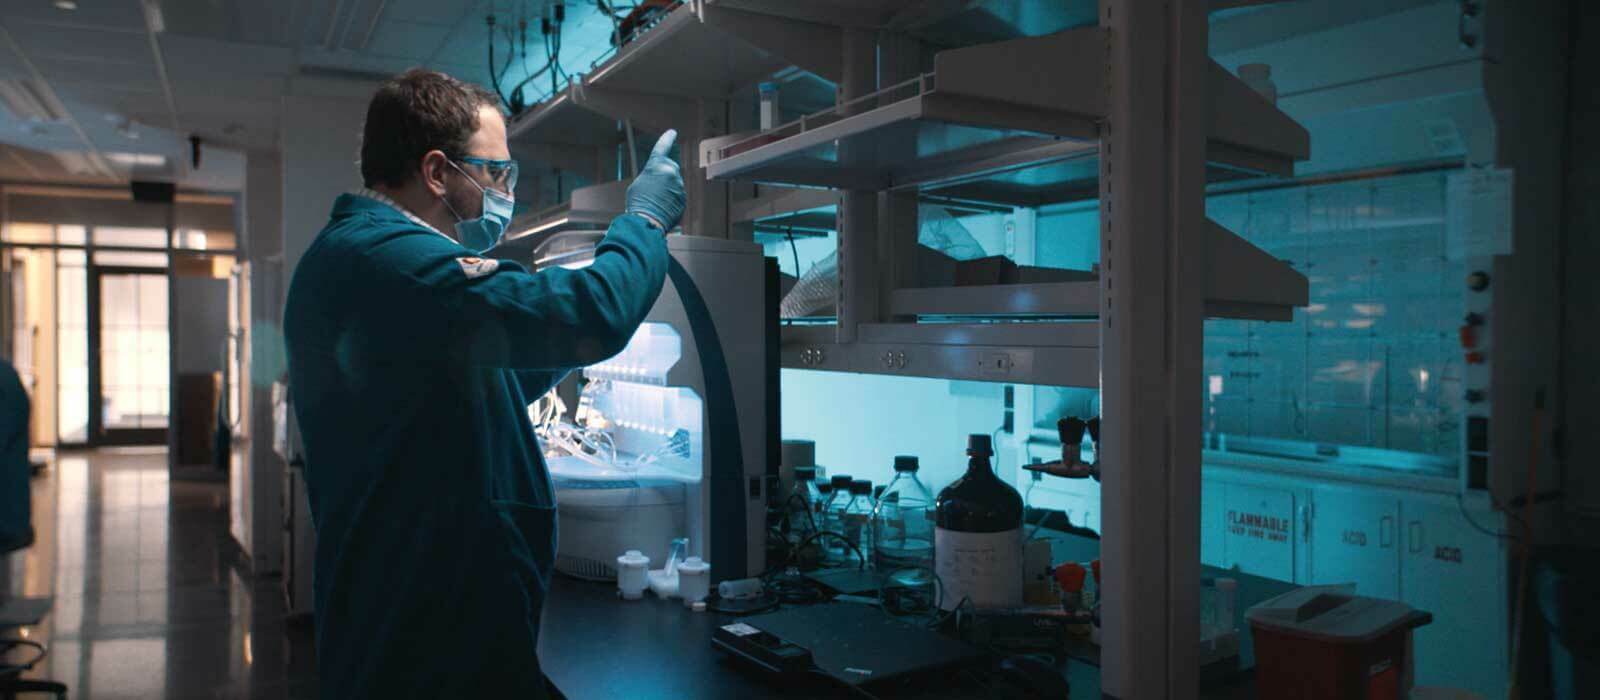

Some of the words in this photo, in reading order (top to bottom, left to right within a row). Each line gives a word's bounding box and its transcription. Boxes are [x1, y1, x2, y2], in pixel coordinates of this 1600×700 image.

[1228, 511, 1288, 533] FLAMMABLE
[1342, 529, 1366, 546] ACID
[1434, 546, 1462, 563] ACID
